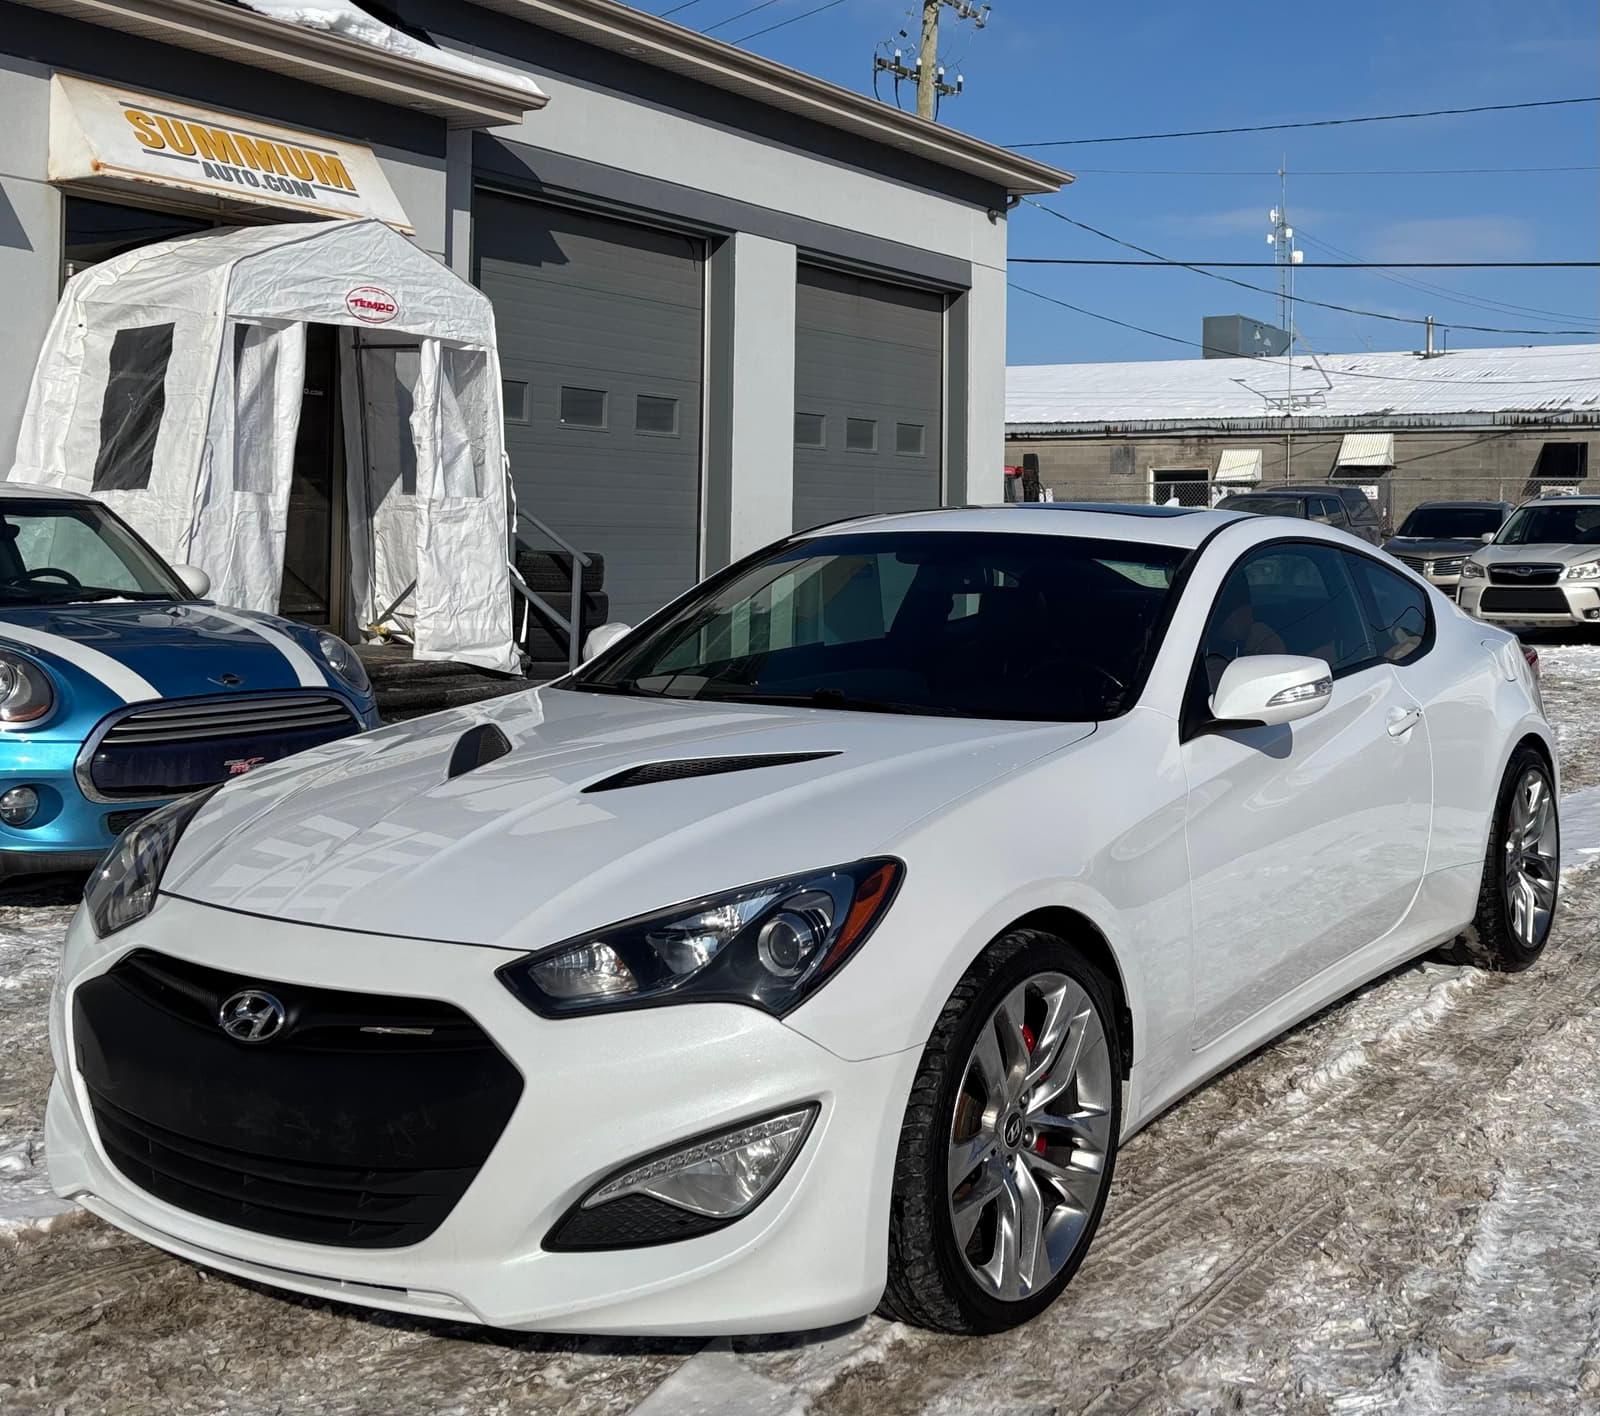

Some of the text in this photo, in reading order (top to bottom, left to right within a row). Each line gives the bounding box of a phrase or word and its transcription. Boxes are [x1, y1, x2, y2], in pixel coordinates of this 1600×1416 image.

[124, 110, 357, 191] SUMMUM
[202, 161, 317, 199] AUTO.COM
[349, 298, 395, 312] TEMPO
